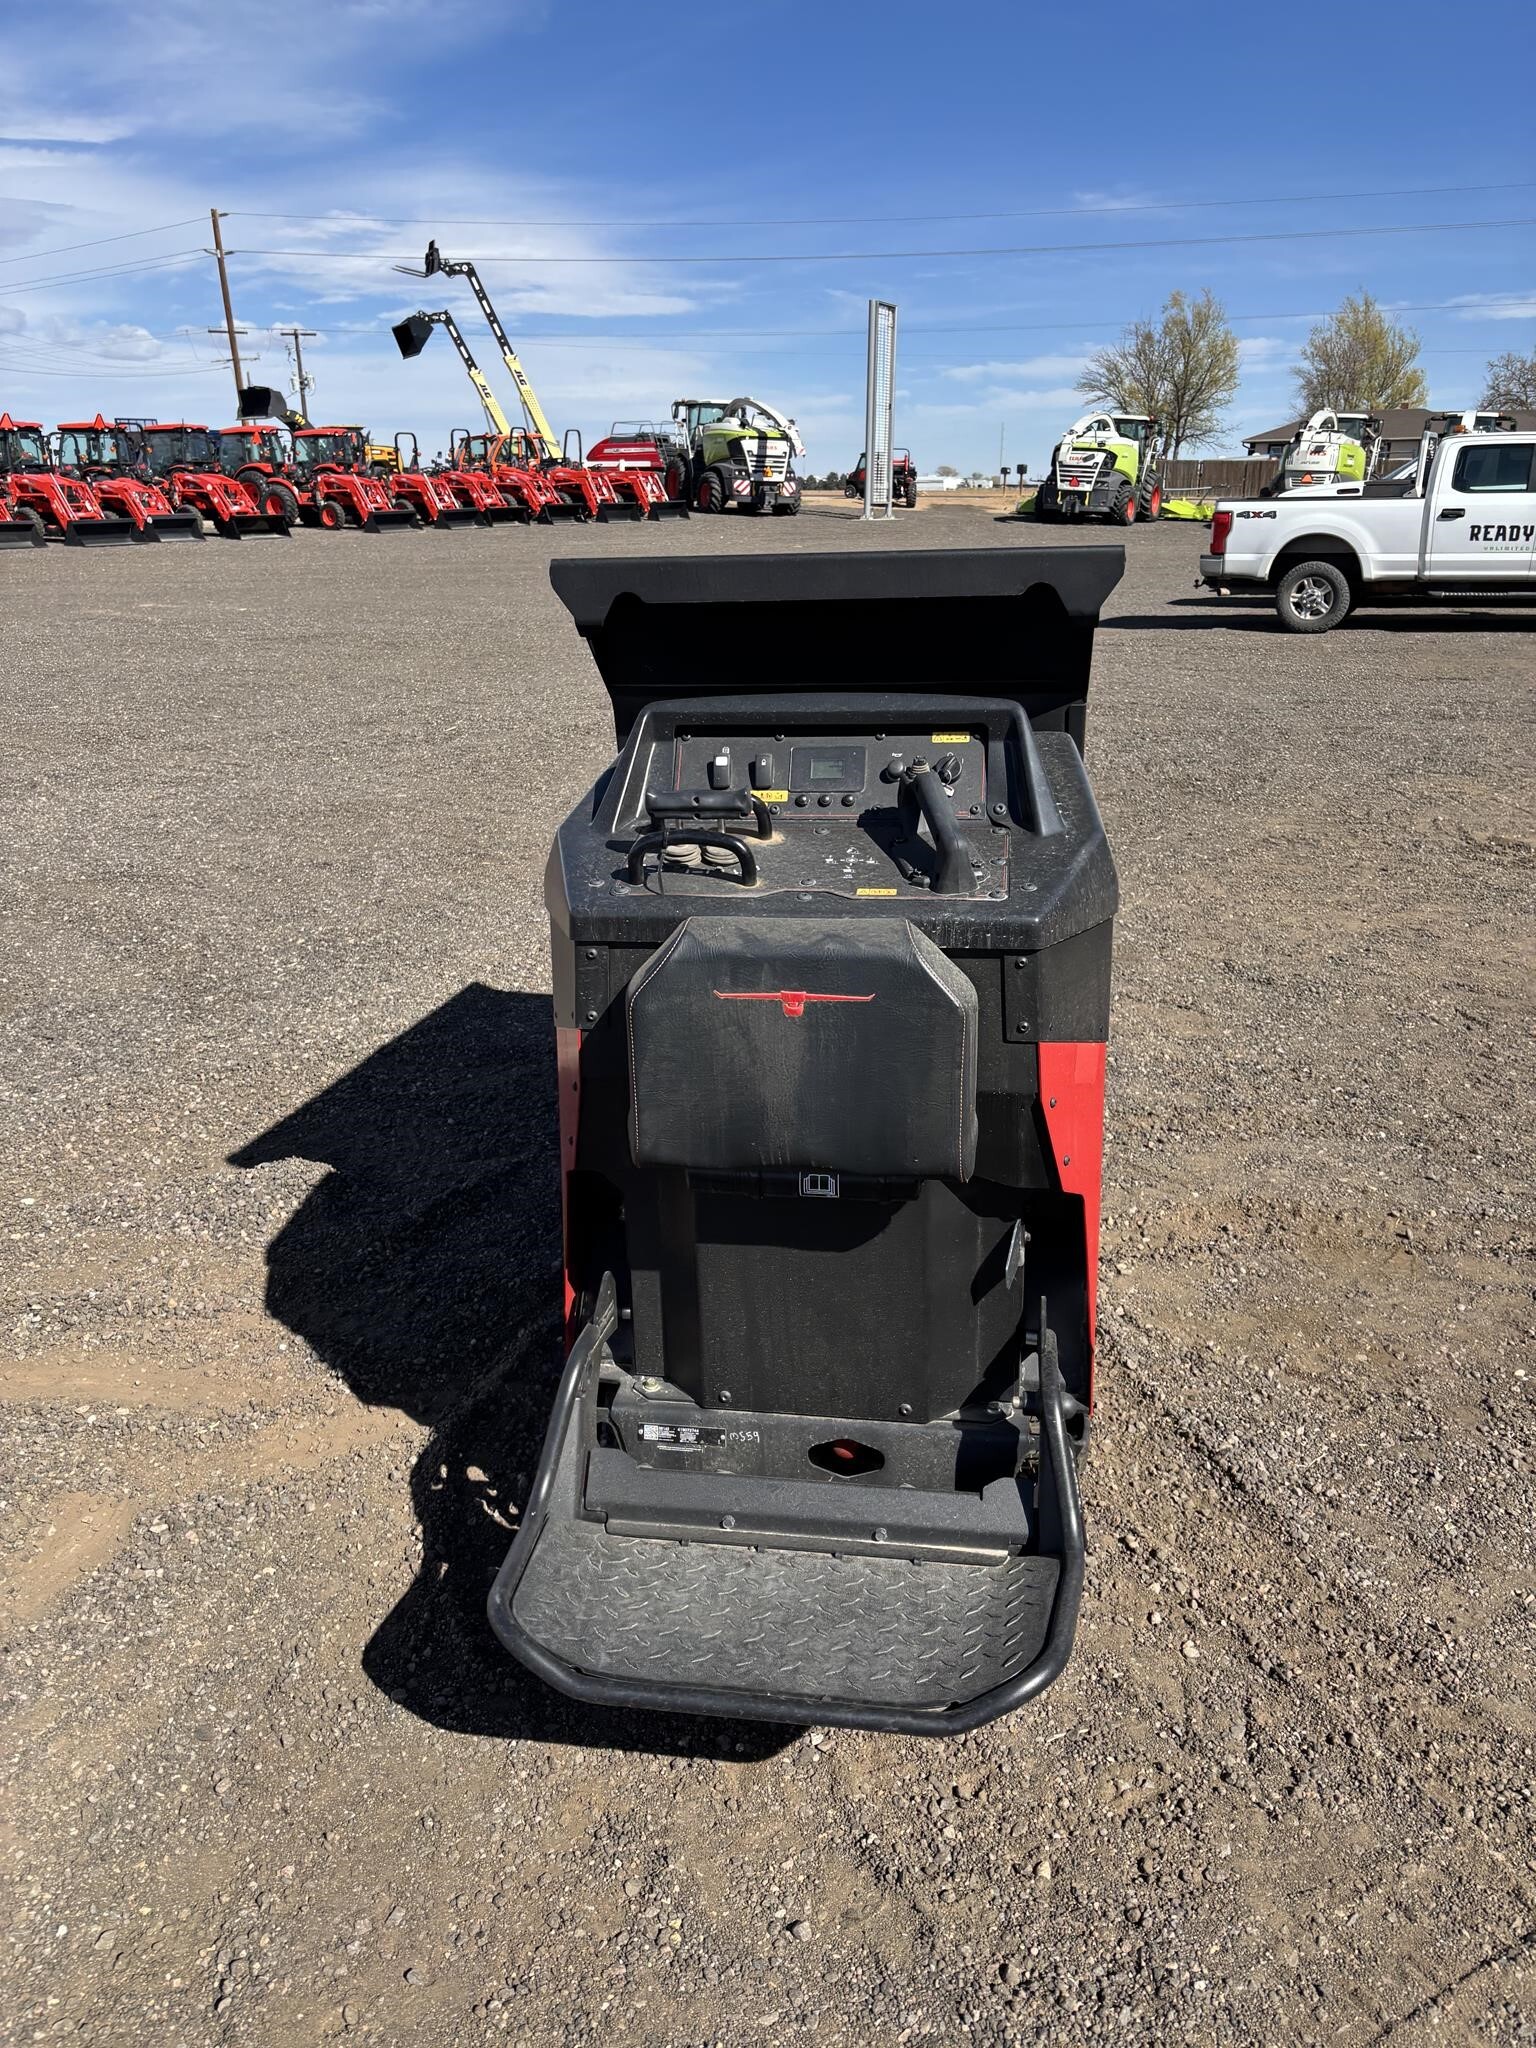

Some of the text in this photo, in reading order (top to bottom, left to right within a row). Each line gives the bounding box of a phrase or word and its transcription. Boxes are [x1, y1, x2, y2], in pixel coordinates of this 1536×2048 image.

[514, 369, 527, 386] JLG
[479, 383, 492, 398] JLG
[1469, 524, 1535, 541] READY
